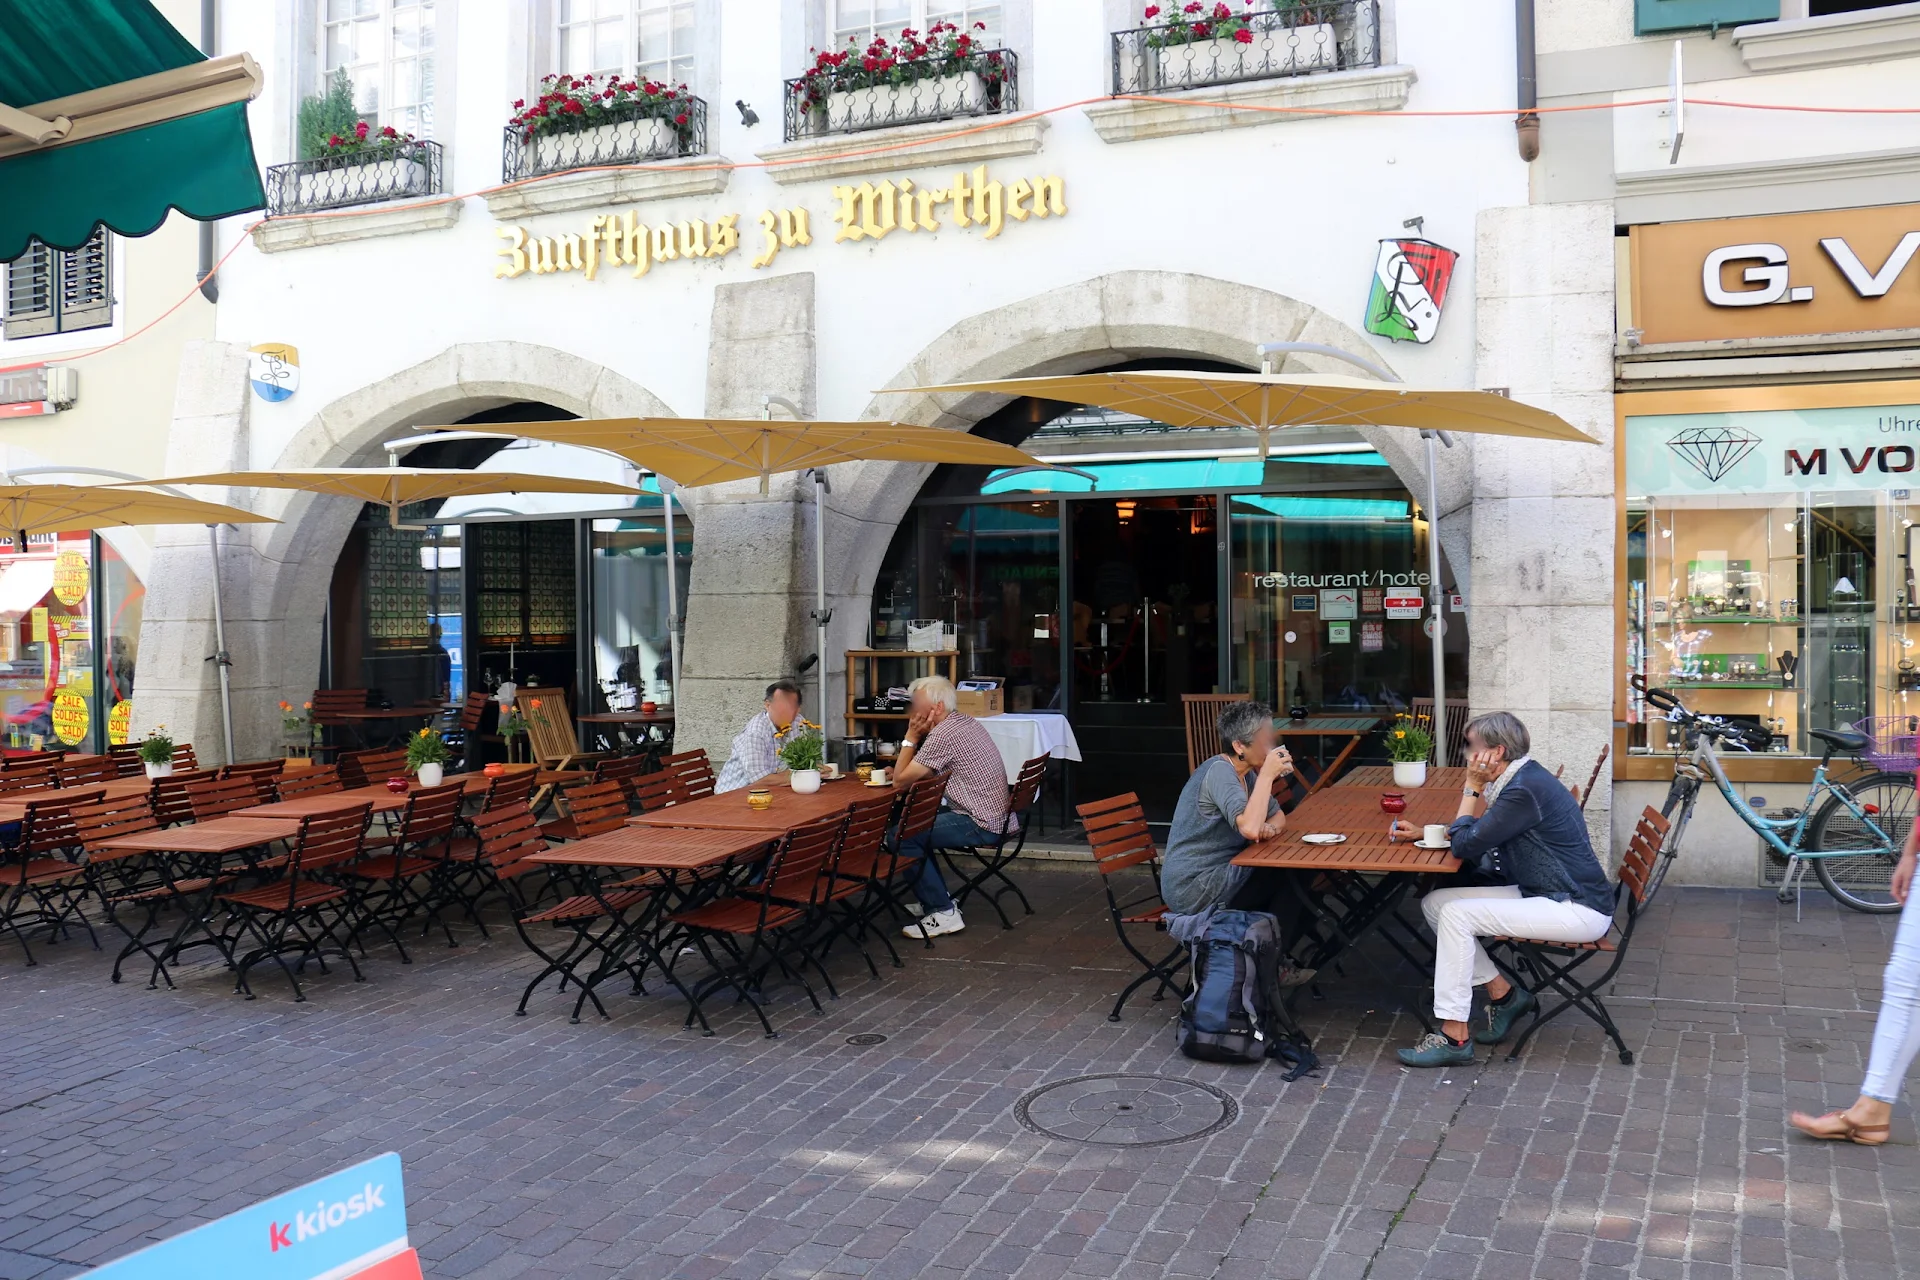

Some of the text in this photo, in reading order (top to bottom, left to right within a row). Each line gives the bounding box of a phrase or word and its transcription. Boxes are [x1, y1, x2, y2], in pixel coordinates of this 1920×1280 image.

[496, 164, 1068, 281] Zunfthaus zu Wirthen
[61, 555, 80, 566] SALE
[54, 570, 82, 581] SOLDES
[1254, 569, 1431, 588] restaurant/hote
[62, 586, 84, 597] SALDI
[62, 695, 81, 708] SALE
[54, 709, 83, 723] SOLDES
[62, 725, 84, 739] SALDI
[110, 720, 130, 733] SOLD
[269, 1182, 386, 1253] k kiosk
